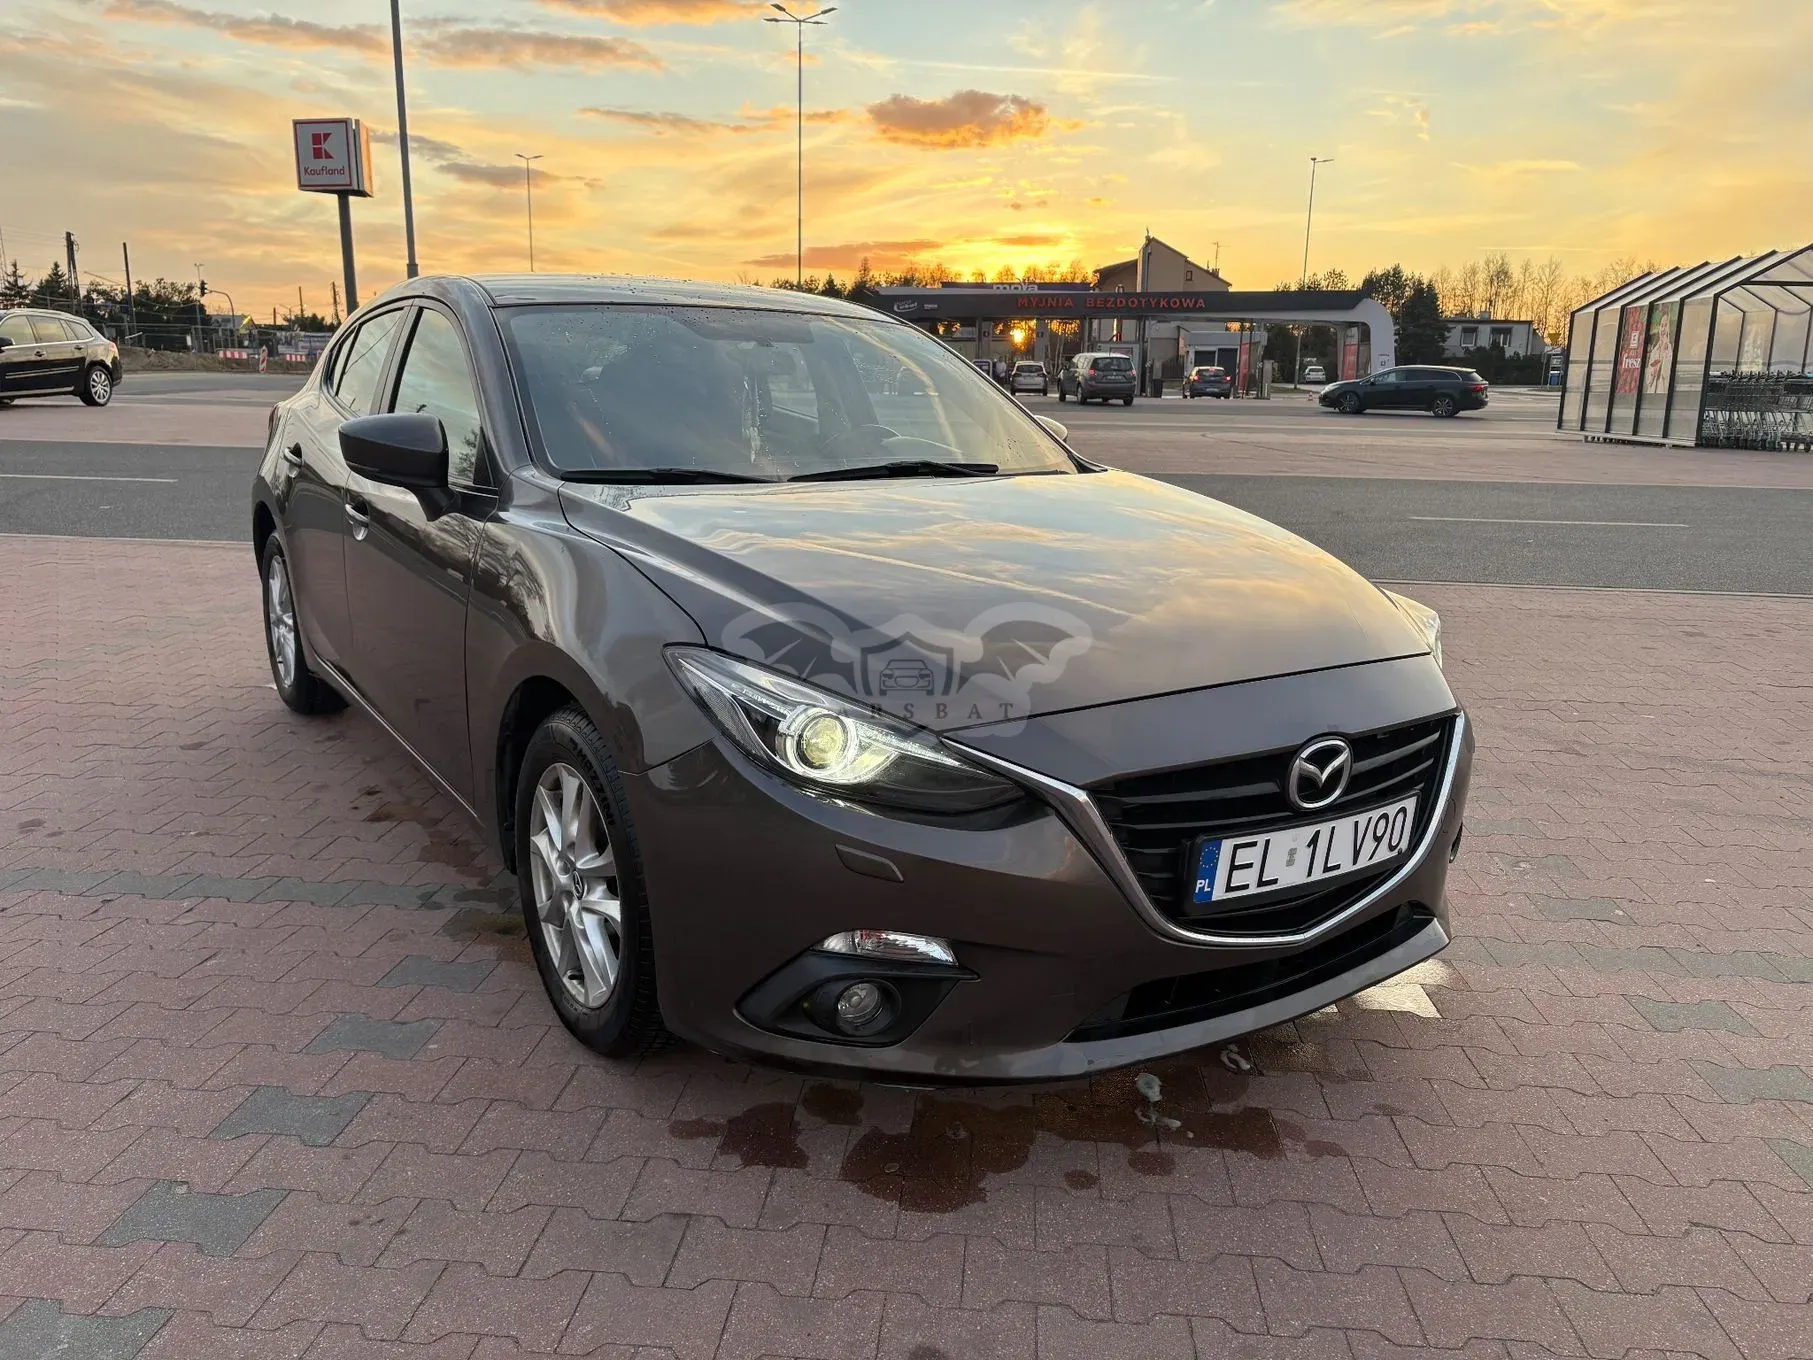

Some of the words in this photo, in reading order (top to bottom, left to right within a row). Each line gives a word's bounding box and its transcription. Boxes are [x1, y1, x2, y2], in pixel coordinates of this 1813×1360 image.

[312, 132, 335, 160] K
[304, 166, 345, 177] Kaufland
[1017, 297, 1073, 309] MYJNIA
[1086, 297, 1206, 309] BEZDOTYKOWA
[1225, 838, 1279, 894] EL
[1305, 805, 1408, 879] 1LV90
[1195, 879, 1212, 894] PL
